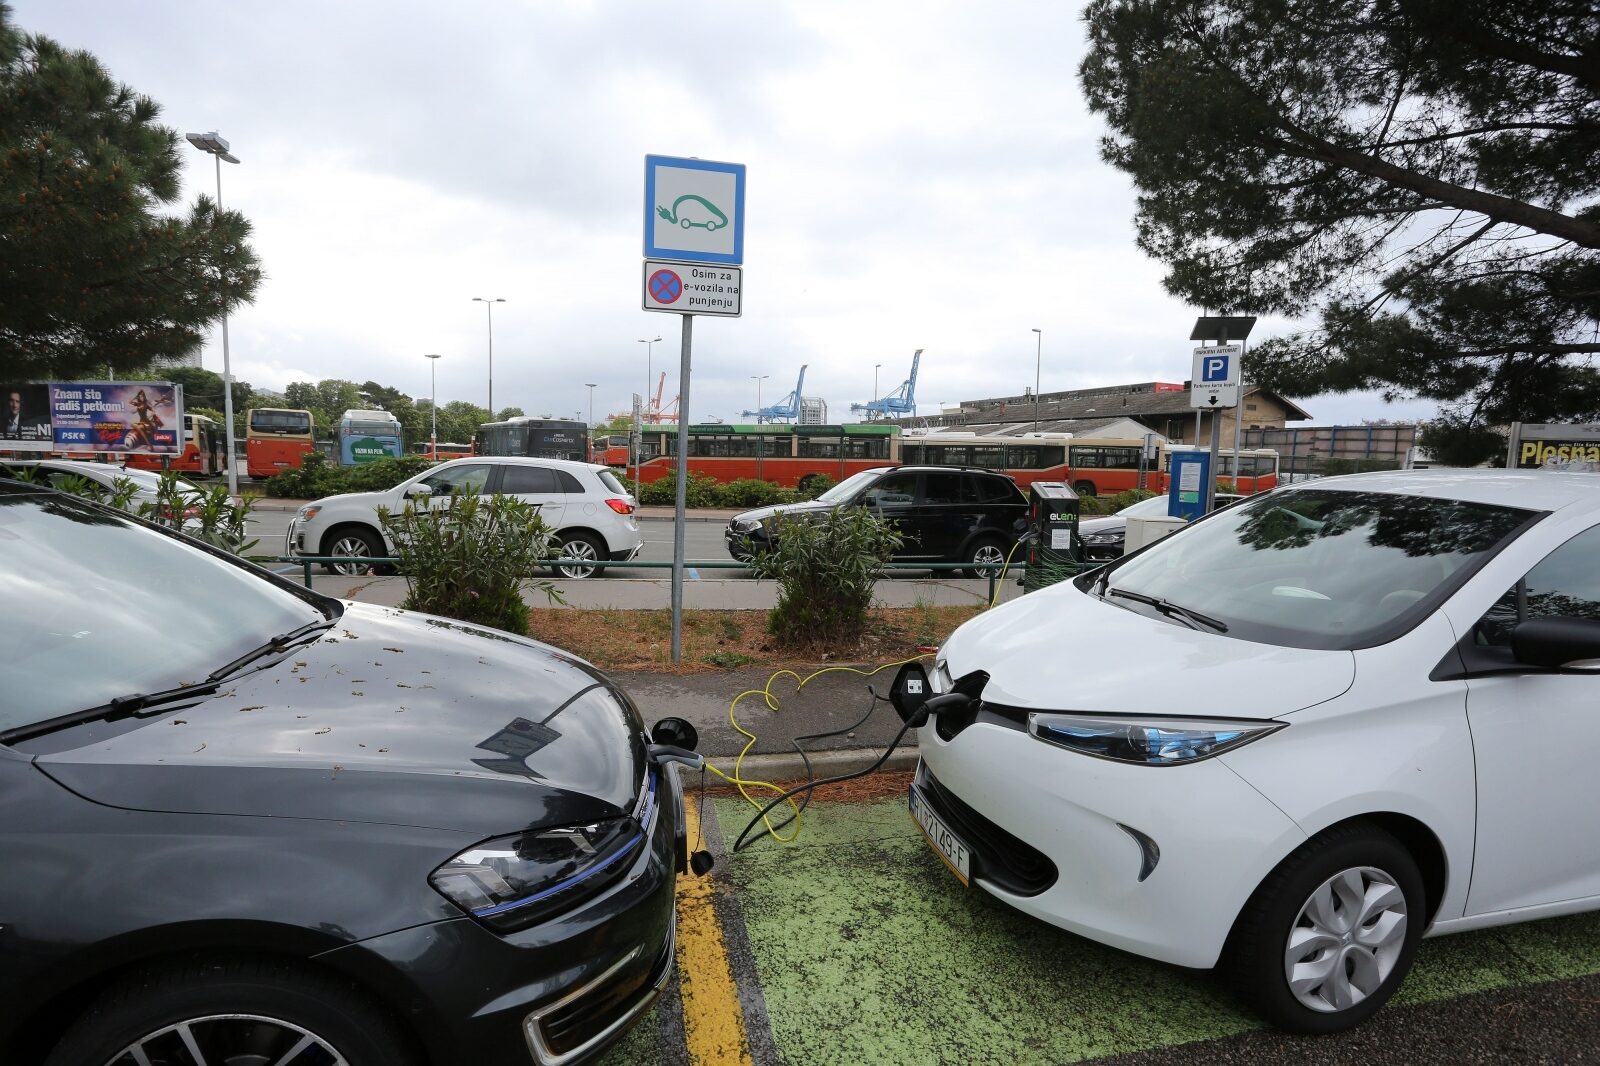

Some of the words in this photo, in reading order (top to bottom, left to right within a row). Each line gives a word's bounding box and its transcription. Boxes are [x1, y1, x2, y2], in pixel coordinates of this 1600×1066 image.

[692, 269, 717, 279] Osim
[683, 283, 724, 293] e-vozila
[727, 286, 739, 294] na
[689, 296, 733, 308] punjenju
[1208, 359, 1224, 379] P
[54, 389, 82, 399] Znam
[84, 388, 102, 400] što
[55, 401, 80, 411] radiš
[83, 401, 125, 413] petkom!
[37, 423, 52, 436] N1
[1520, 441, 1600, 465] Plesna
